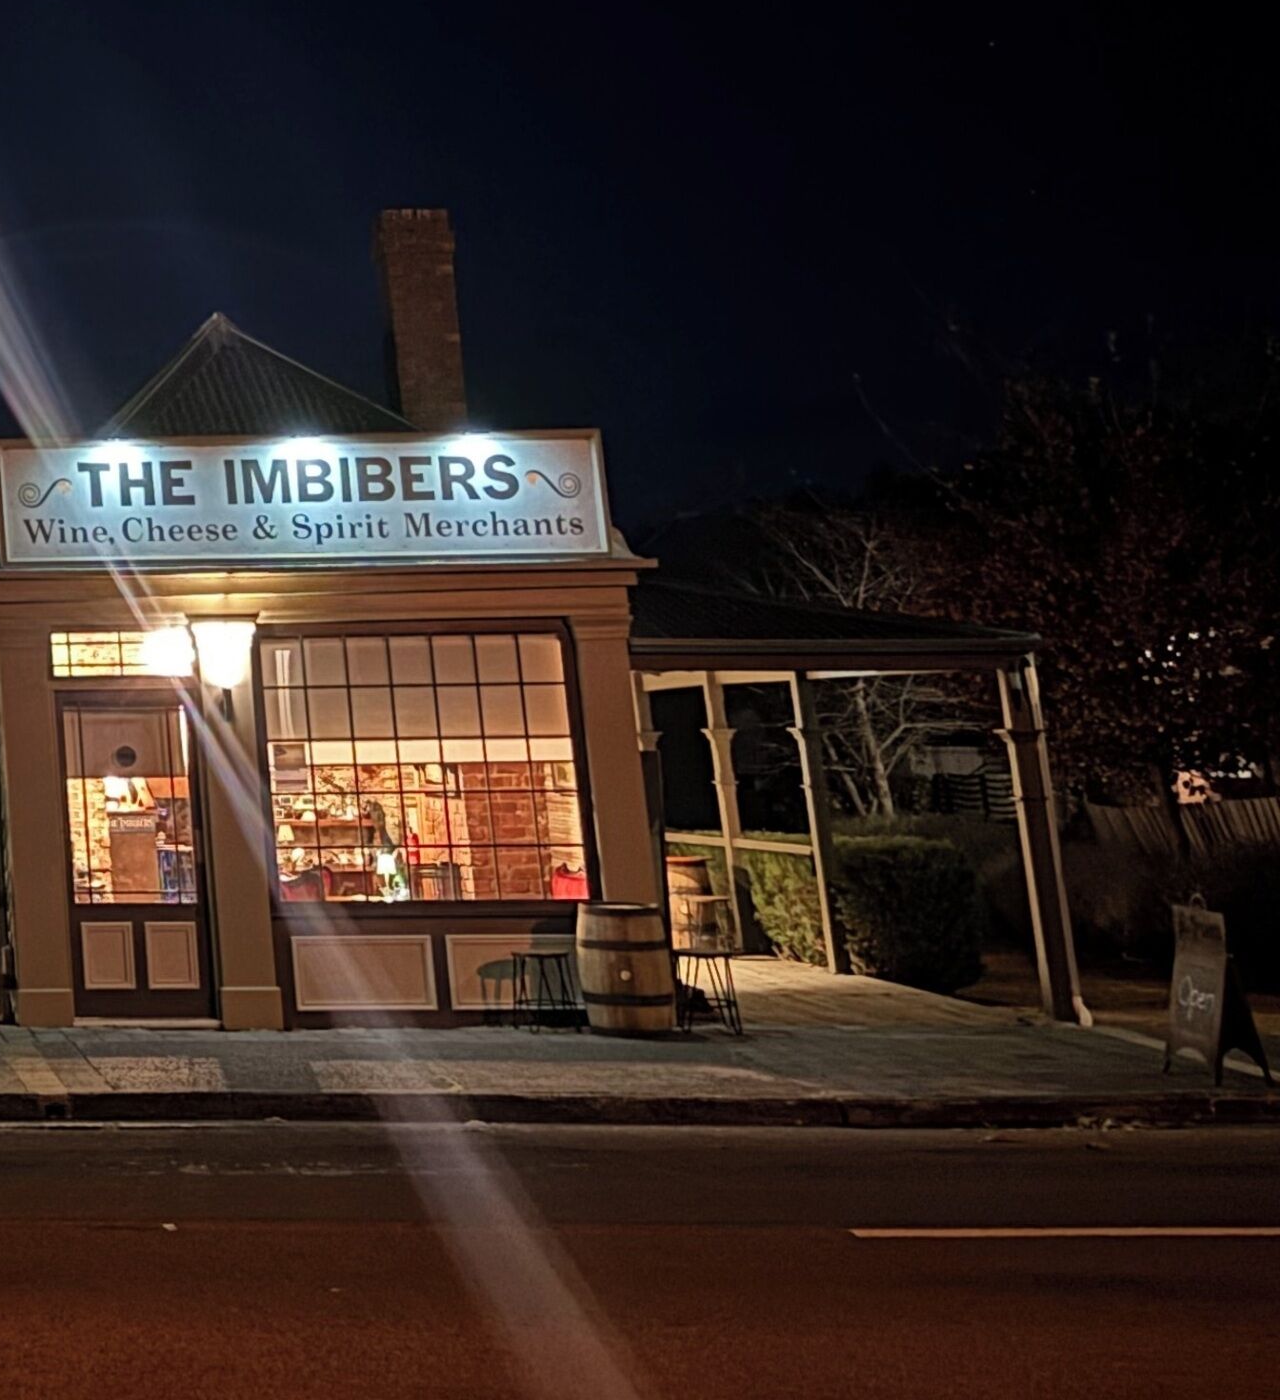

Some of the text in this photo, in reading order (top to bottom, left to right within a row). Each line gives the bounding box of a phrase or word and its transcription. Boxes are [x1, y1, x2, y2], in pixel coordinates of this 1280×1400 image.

[77, 454, 521, 508] THE IMBIBERS
[23, 509, 585, 546] Wine, Cheese & Spirit Merchants
[1178, 975, 1216, 1021] Open
